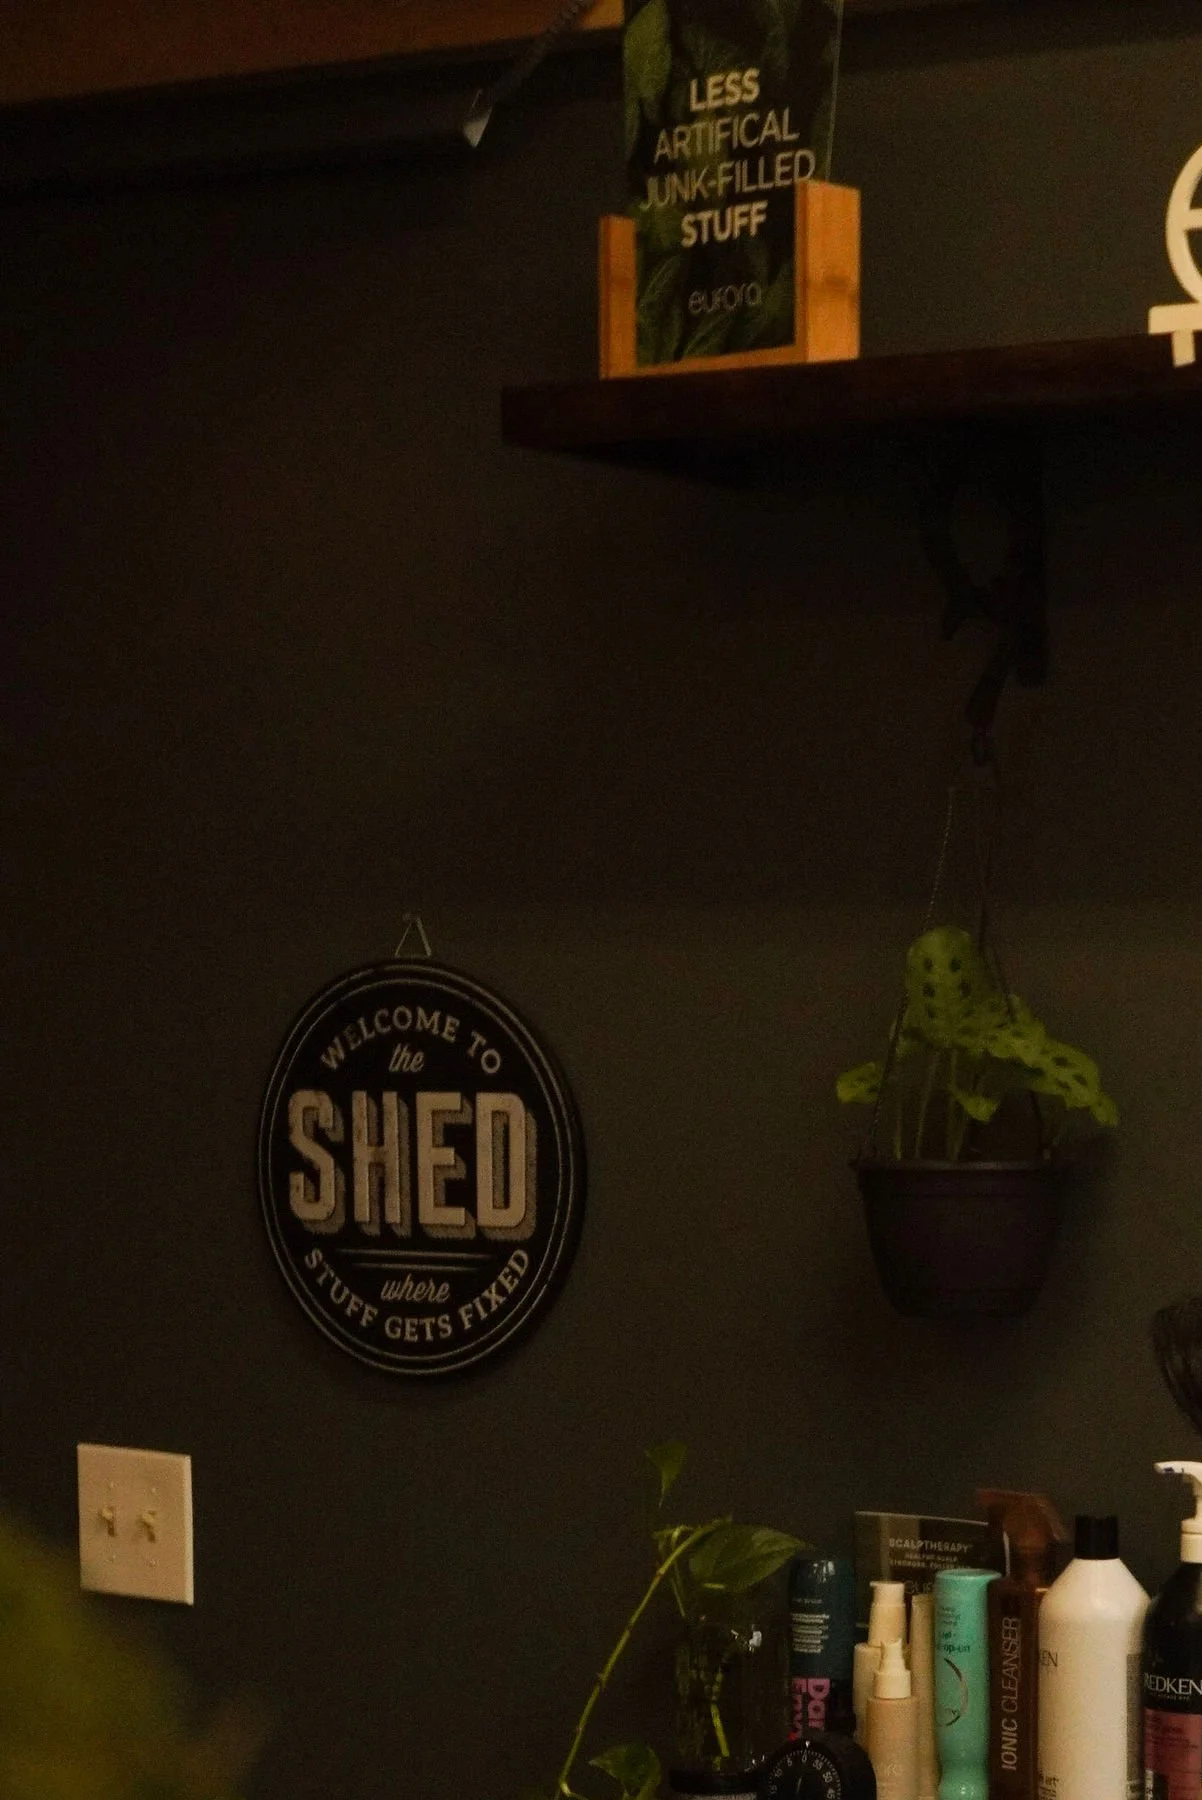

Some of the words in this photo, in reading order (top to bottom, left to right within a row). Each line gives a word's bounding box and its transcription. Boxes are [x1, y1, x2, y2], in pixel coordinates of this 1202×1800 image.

[690, 67, 760, 112] LESS
[653, 106, 801, 164] ARTIFICAL
[640, 148, 816, 210] JUNK-FILLED
[680, 200, 768, 248] STUFF
[688, 282, 762, 314] eufora
[319, 1004, 460, 1072] WELCOME
[466, 1031, 502, 1074] TO
[388, 1040, 424, 1073] the
[287, 1088, 538, 1241] SHED
[303, 1247, 379, 1329] STUFF
[384, 1311, 454, 1343] GETS
[457, 1247, 531, 1332] FIXED
[379, 1272, 452, 1304] where
[1000, 1616, 1020, 1714] CLEANSER
[1144, 1672, 1202, 1695] REDKEN
[1001, 1718, 1018, 1771] IONIC
